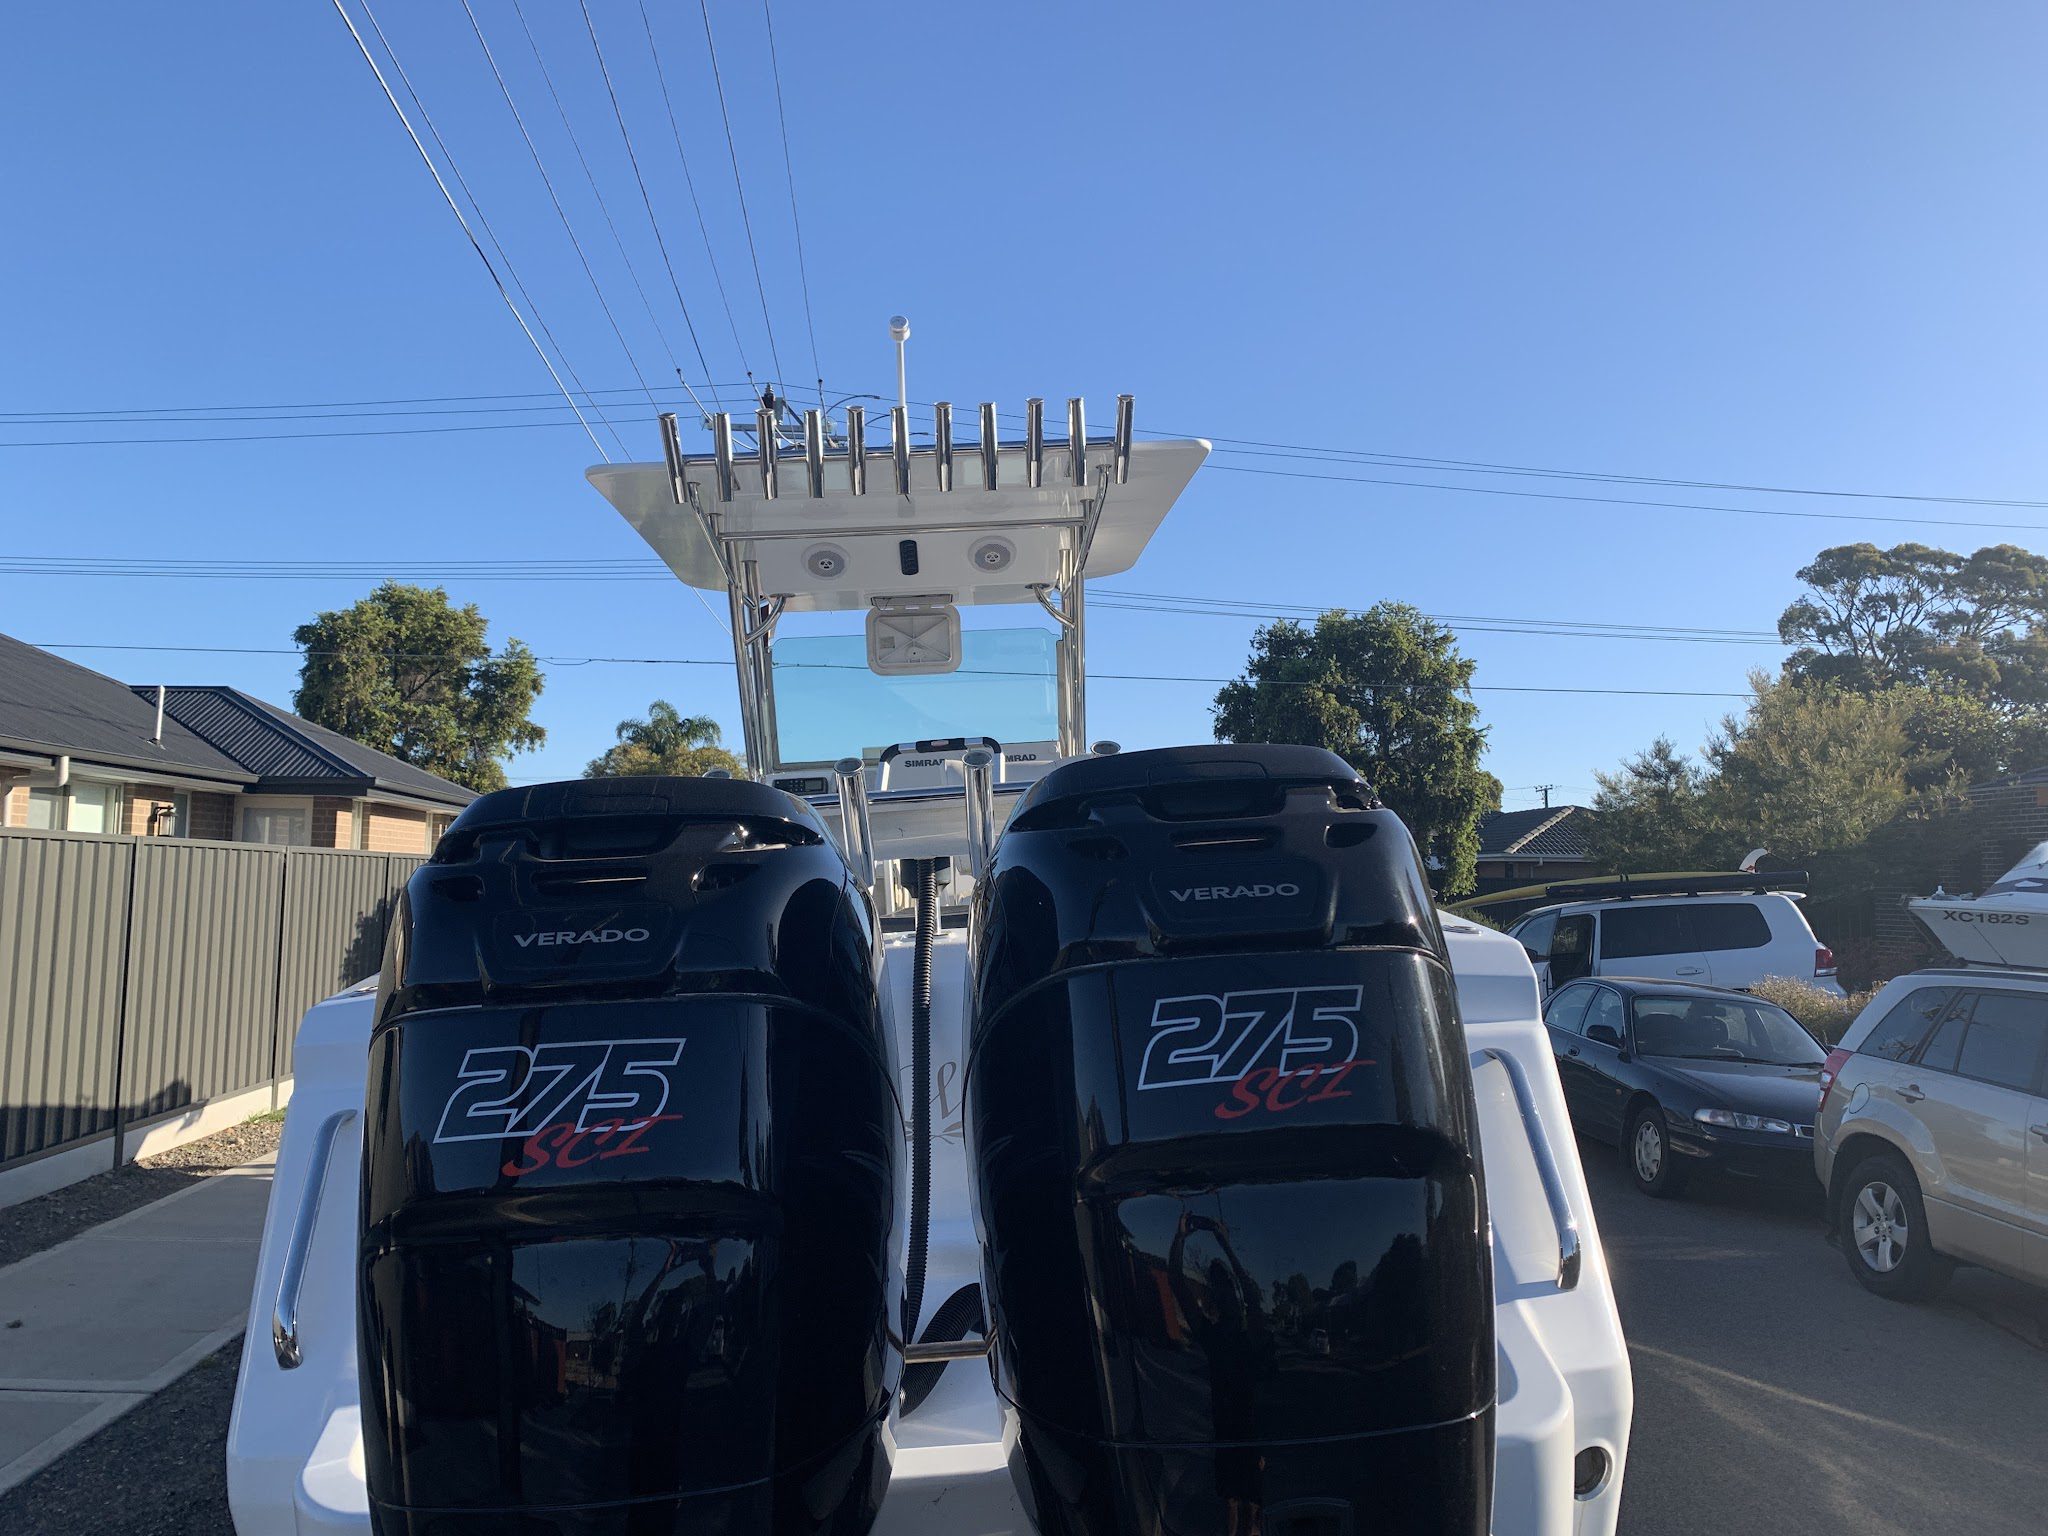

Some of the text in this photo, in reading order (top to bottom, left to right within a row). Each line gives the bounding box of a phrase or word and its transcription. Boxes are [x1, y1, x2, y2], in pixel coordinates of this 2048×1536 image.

[904, 758, 945, 768] SIMRA
[1005, 753, 1037, 763] MRAD
[1169, 883, 1300, 902] VERADO
[1943, 909, 2030, 926] XC182S
[513, 928, 650, 948] VERADO
[1137, 984, 1364, 1091] 275
[433, 1037, 687, 1144] 275
